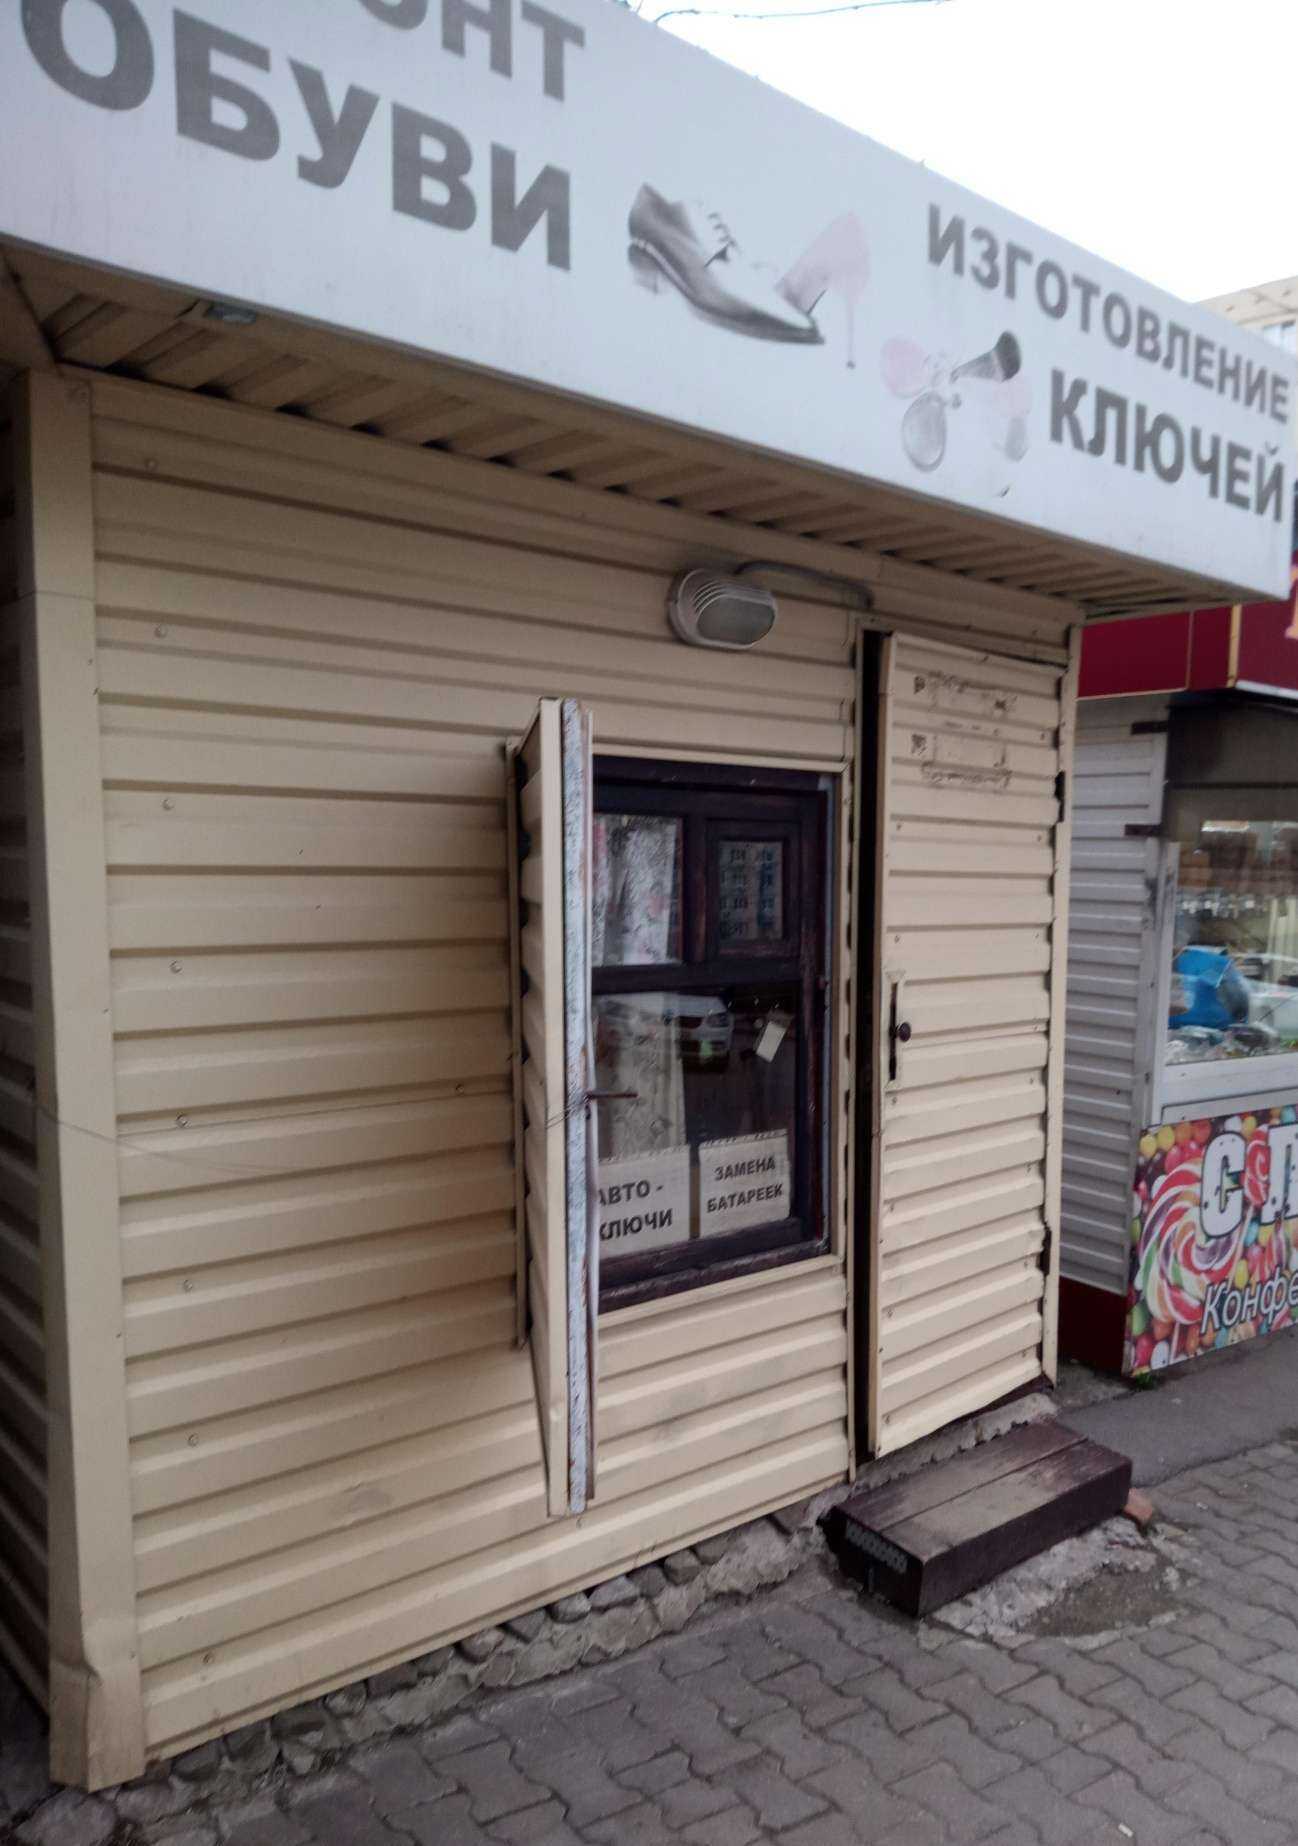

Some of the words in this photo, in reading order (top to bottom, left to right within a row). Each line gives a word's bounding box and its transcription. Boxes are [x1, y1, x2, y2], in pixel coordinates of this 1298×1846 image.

[21, 0, 571, 271] ОБУВИ
[927, 203, 1289, 424] ИЗГОТОВЛЕНИЕ
[1050, 368, 1285, 522] КЛЮЧЕЙ
[707, 1183, 784, 1213] БАТАРЕЕК
[714, 1155, 776, 1181] ЗАМЕНА
